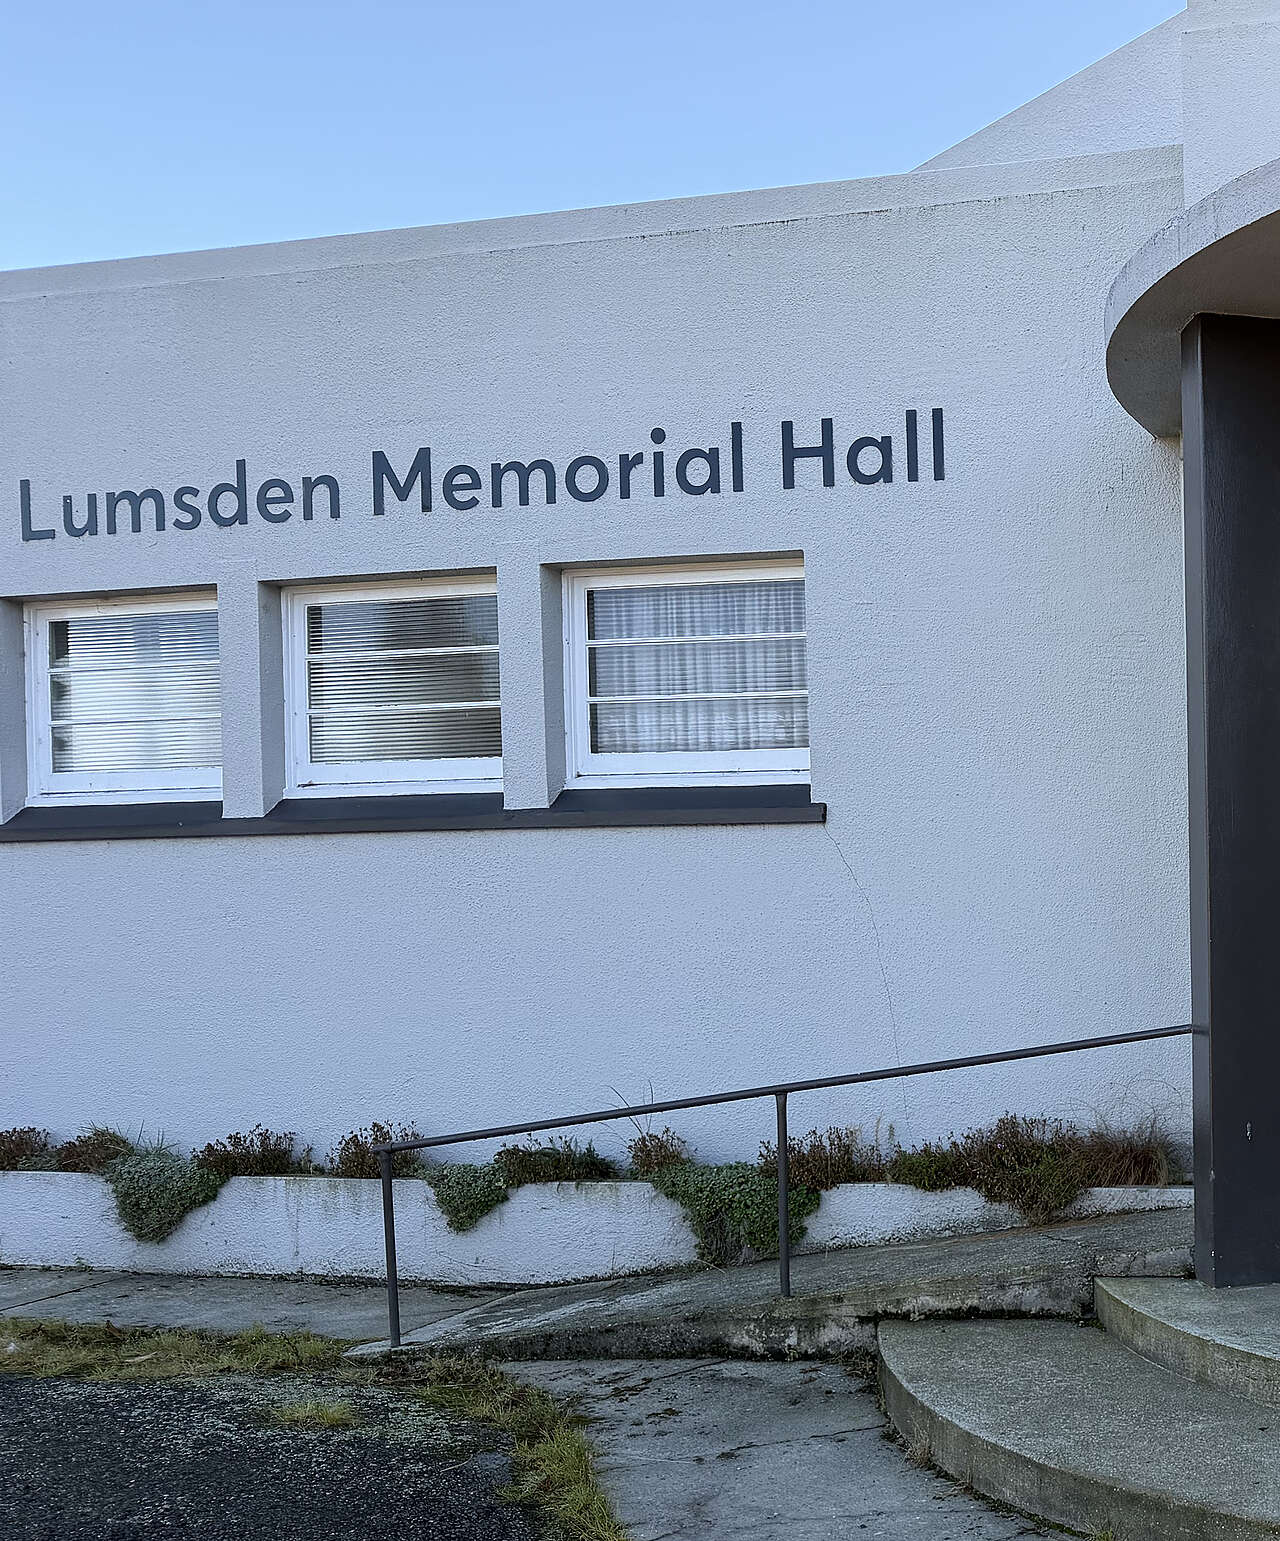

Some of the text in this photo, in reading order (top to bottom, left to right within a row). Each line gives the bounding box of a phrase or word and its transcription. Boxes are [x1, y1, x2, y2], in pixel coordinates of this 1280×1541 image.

[19, 407, 946, 543] Lumsden Memorial Hall
